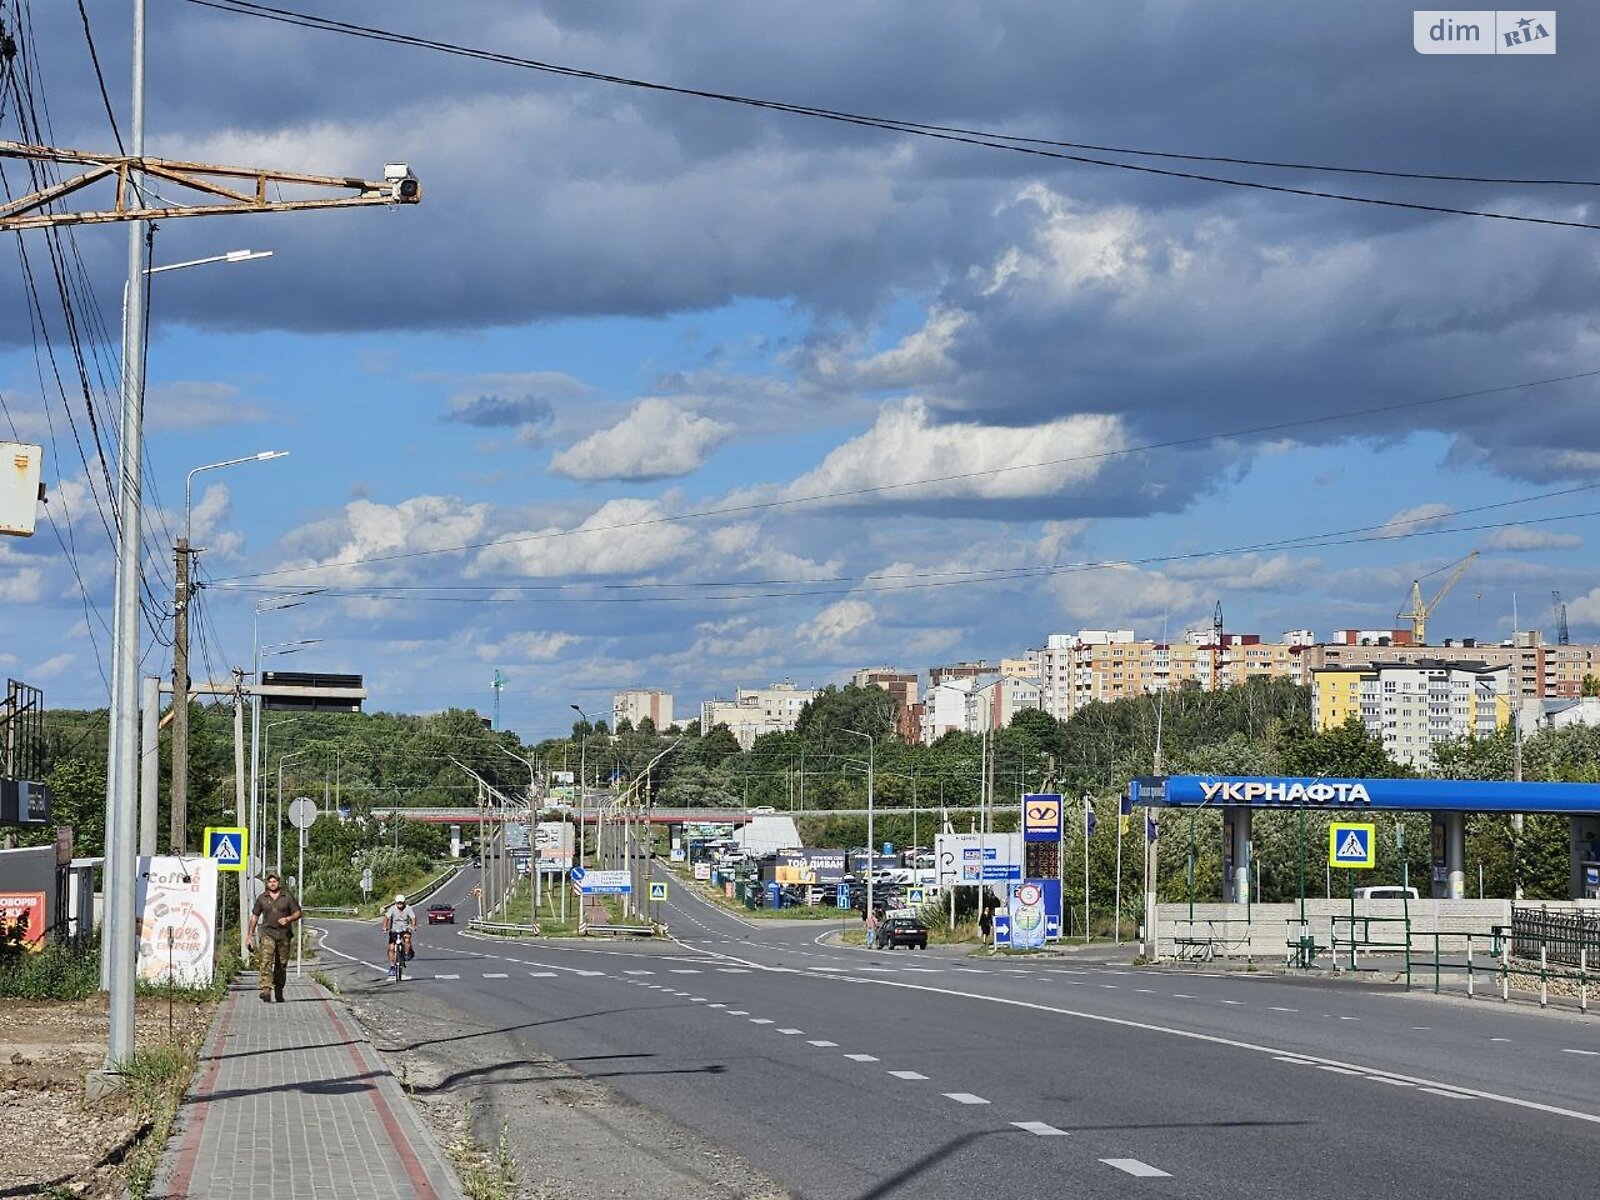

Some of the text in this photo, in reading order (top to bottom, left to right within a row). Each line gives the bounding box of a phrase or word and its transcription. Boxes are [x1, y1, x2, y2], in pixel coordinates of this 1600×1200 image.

[1199, 782, 1371, 802] УКРНАФТА
[787, 857, 844, 870] ТОЙ ДИВАН
[149, 871, 201, 884] Coffe
